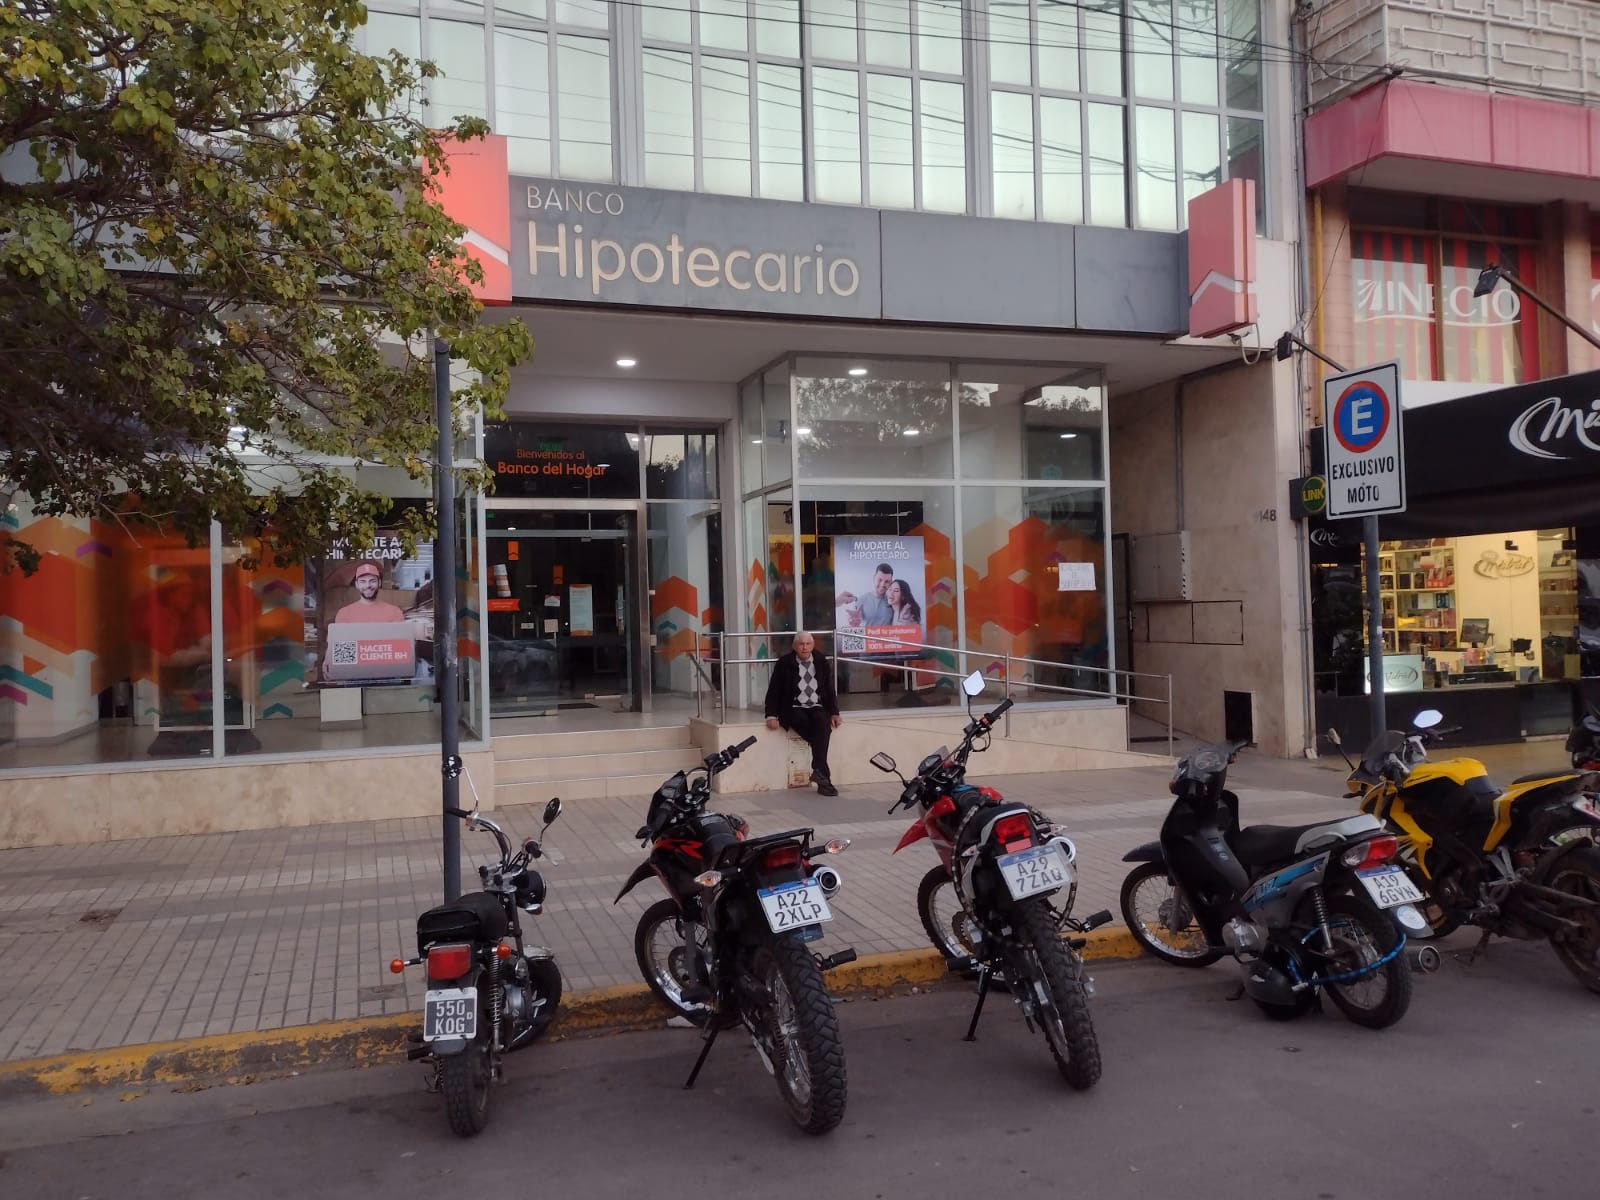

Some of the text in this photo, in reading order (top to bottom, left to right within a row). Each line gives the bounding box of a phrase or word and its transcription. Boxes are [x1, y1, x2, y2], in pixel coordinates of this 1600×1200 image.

[526, 185, 625, 216] BANCO
[528, 220, 860, 297] Hipotecario
[1351, 397, 1375, 436] E
[517, 448, 585, 460] Bienvenidos al
[498, 462, 606, 478] Banco del Hogar
[1332, 456, 1395, 480] EXCLUSIVO
[1303, 488, 1325, 502] LINK
[1347, 484, 1380, 504] MOTO
[854, 540, 906, 550] MUDATE AL
[849, 550, 910, 560] HIPOTECARIO
[360, 644, 393, 652] HACETE
[360, 651, 408, 661] CLIENTE BH
[1017, 856, 1049, 877] A29
[1372, 874, 1400, 890] A19
[777, 889, 812, 910] A22
[1379, 885, 1418, 905] 6GYN
[774, 903, 822, 927] 2XLP
[436, 999, 466, 1017] 550
[435, 1017, 465, 1035] KOG
